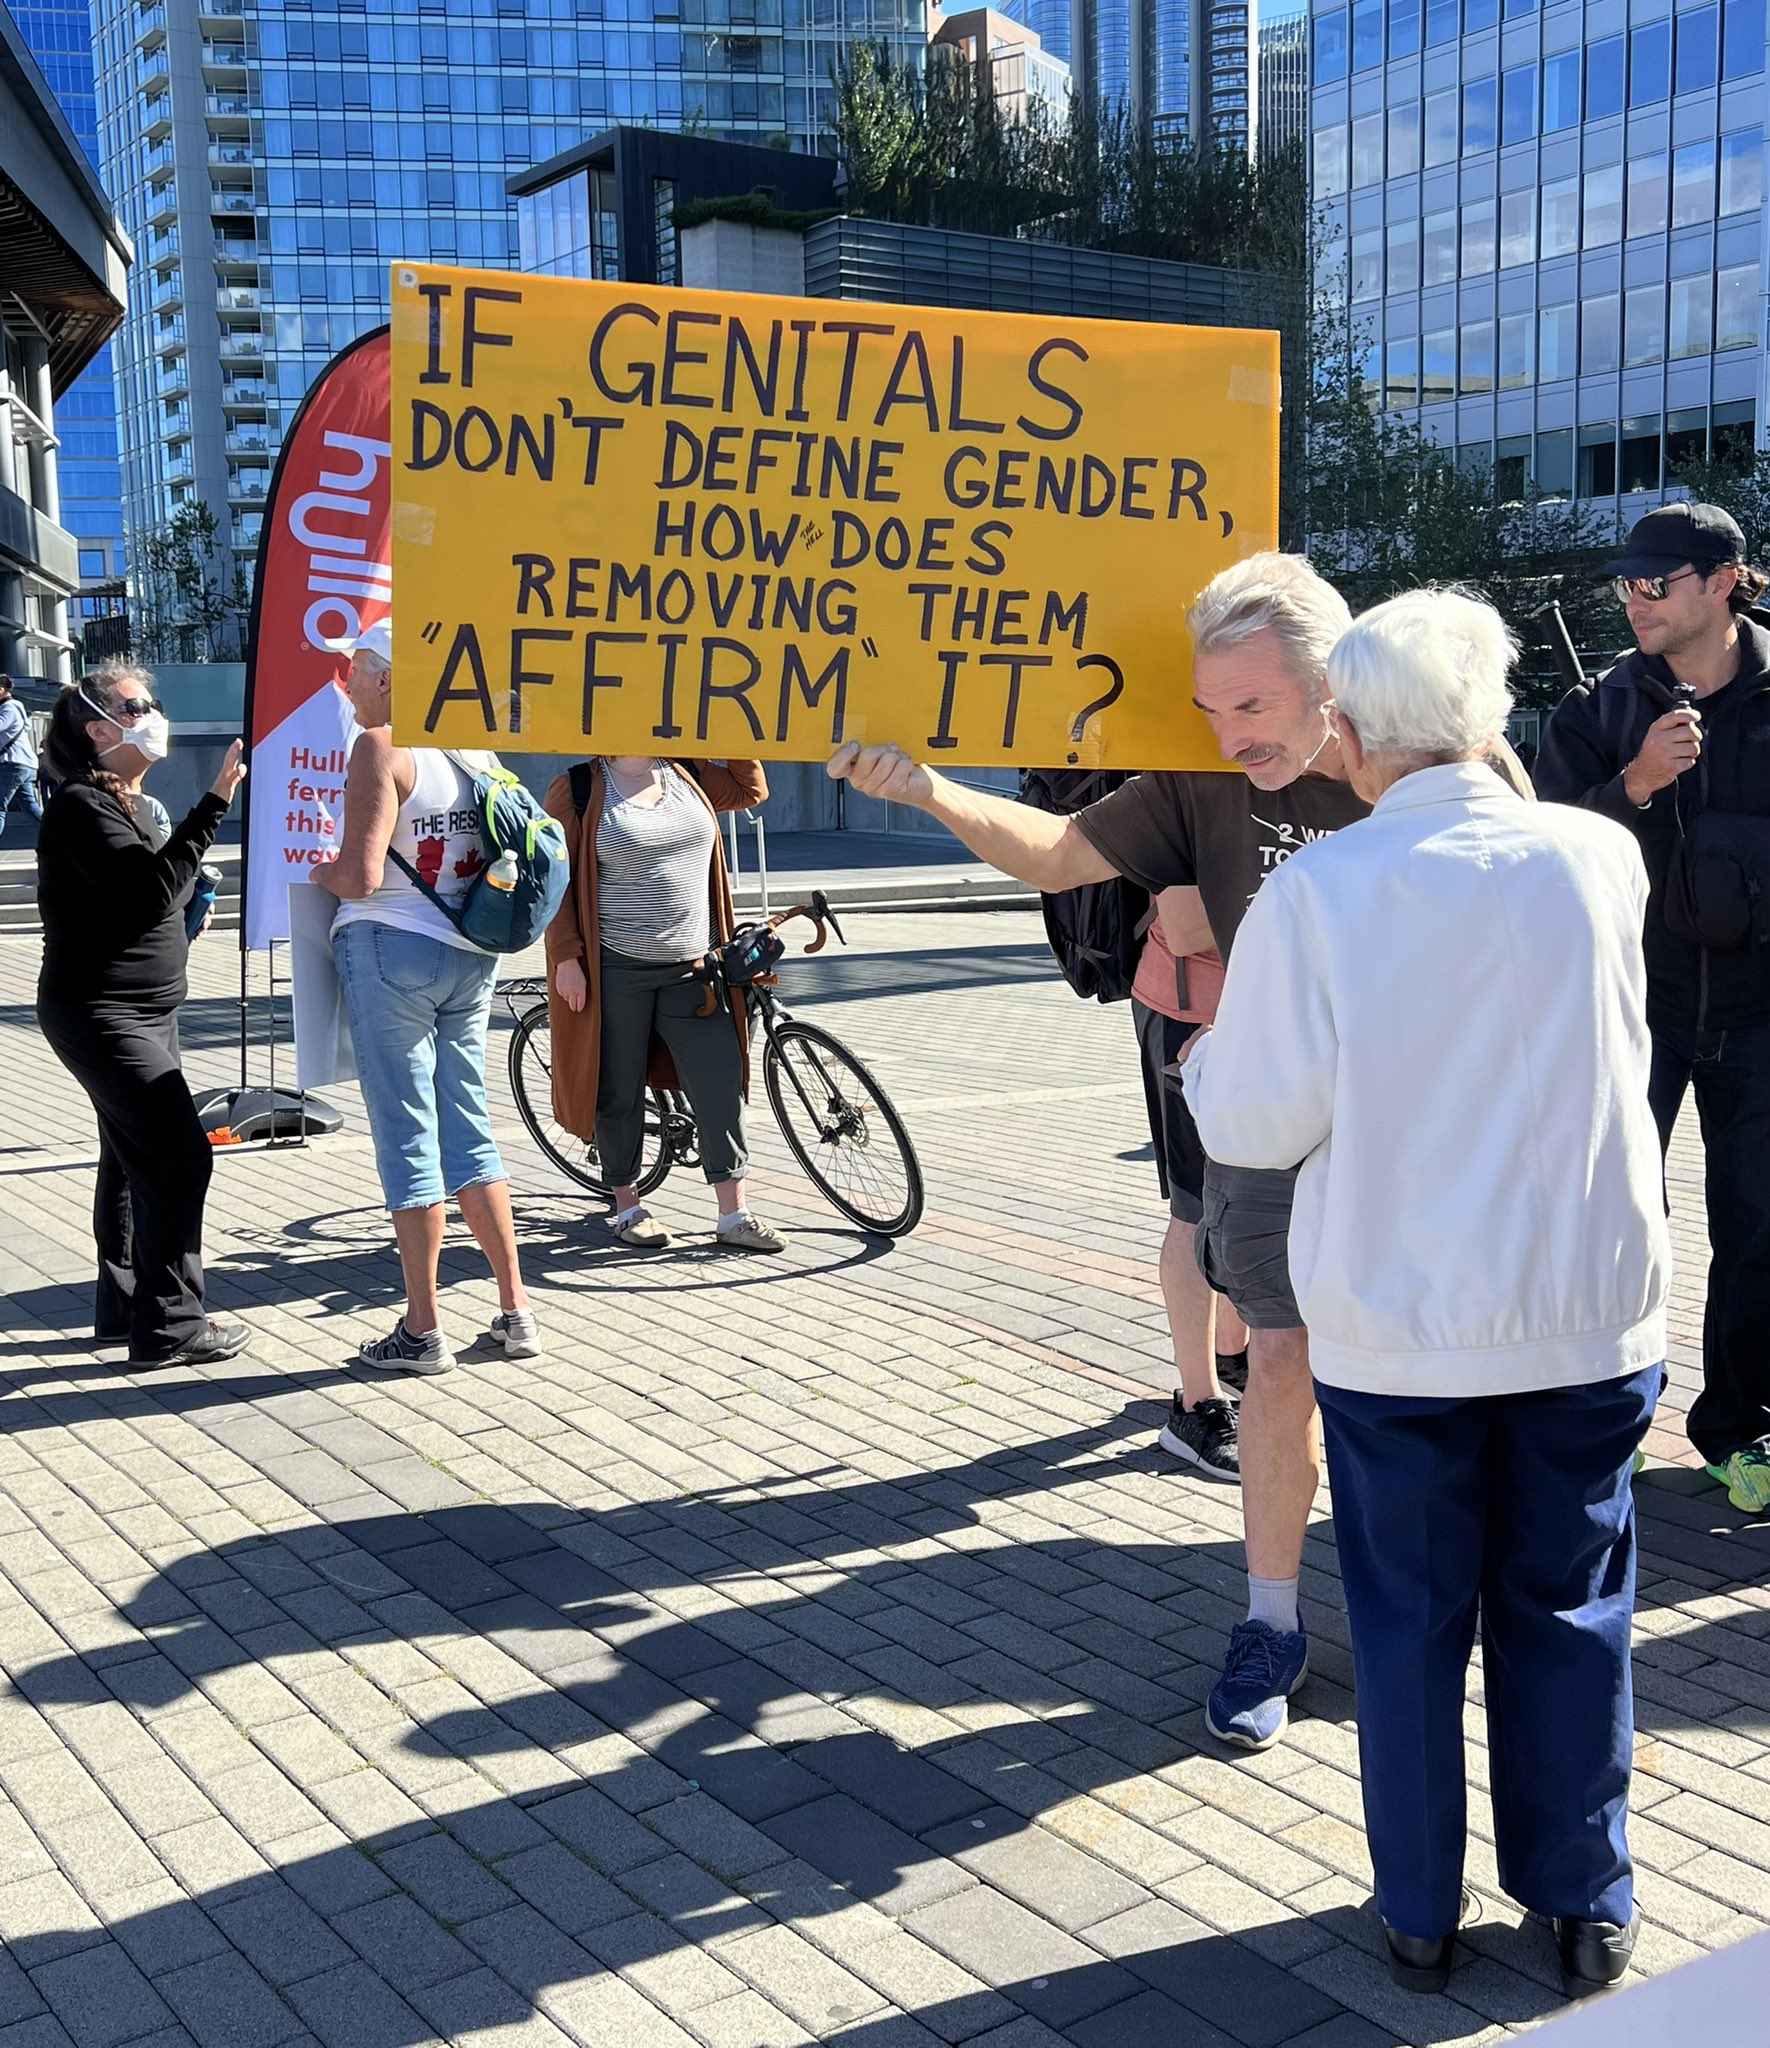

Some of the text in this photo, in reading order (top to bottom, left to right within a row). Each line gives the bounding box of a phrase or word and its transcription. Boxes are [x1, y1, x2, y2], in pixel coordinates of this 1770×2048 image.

[418, 283, 1090, 441] IF GENITALS
[403, 397, 1234, 539] DON'T DEFINE GENDER,
[653, 500, 1014, 576] HOW DOES
[800, 520, 815, 539] THE
[805, 528, 824, 551] HELL
[511, 553, 1090, 651] REMOVING THEM
[420, 621, 1126, 765] "AFFIRM" IT?
[290, 746, 346, 773] Hull
[288, 777, 346, 804] ferr
[285, 809, 336, 835] this
[411, 809, 479, 837] THE RESI
